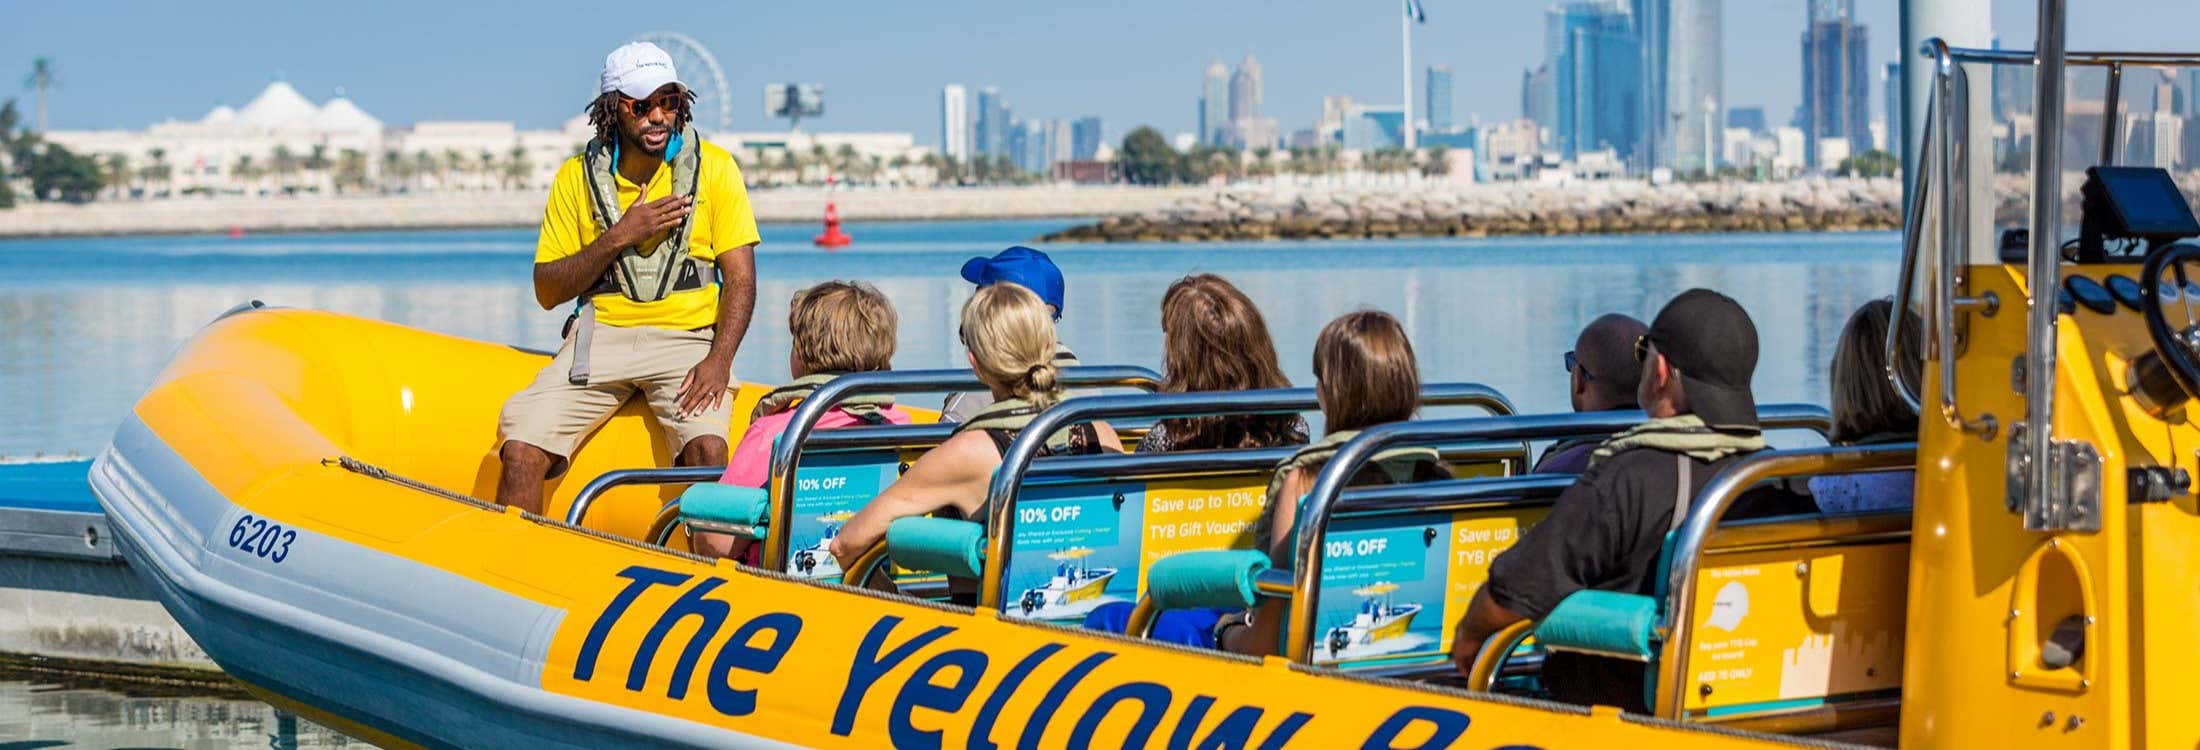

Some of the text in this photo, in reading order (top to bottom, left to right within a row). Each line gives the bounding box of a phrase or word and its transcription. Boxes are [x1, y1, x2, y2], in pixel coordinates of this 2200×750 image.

[798, 477, 847, 491] 10% OFF
[1151, 497, 1184, 513] Save
[1188, 496, 1204, 512] up
[1208, 494, 1222, 509] to
[1227, 492, 1253, 508] 10%
[1019, 505, 1081, 524] 10% OFF
[229, 514, 297, 564] 6203
[1150, 523, 1176, 539] TYB
[1179, 521, 1202, 537] Gift
[1458, 527, 1490, 543] Save
[1494, 527, 1511, 541] up
[1325, 538, 1388, 557] 10% OFF
[1457, 549, 1484, 566] TYB
[572, 565, 1316, 750] The Yellow
